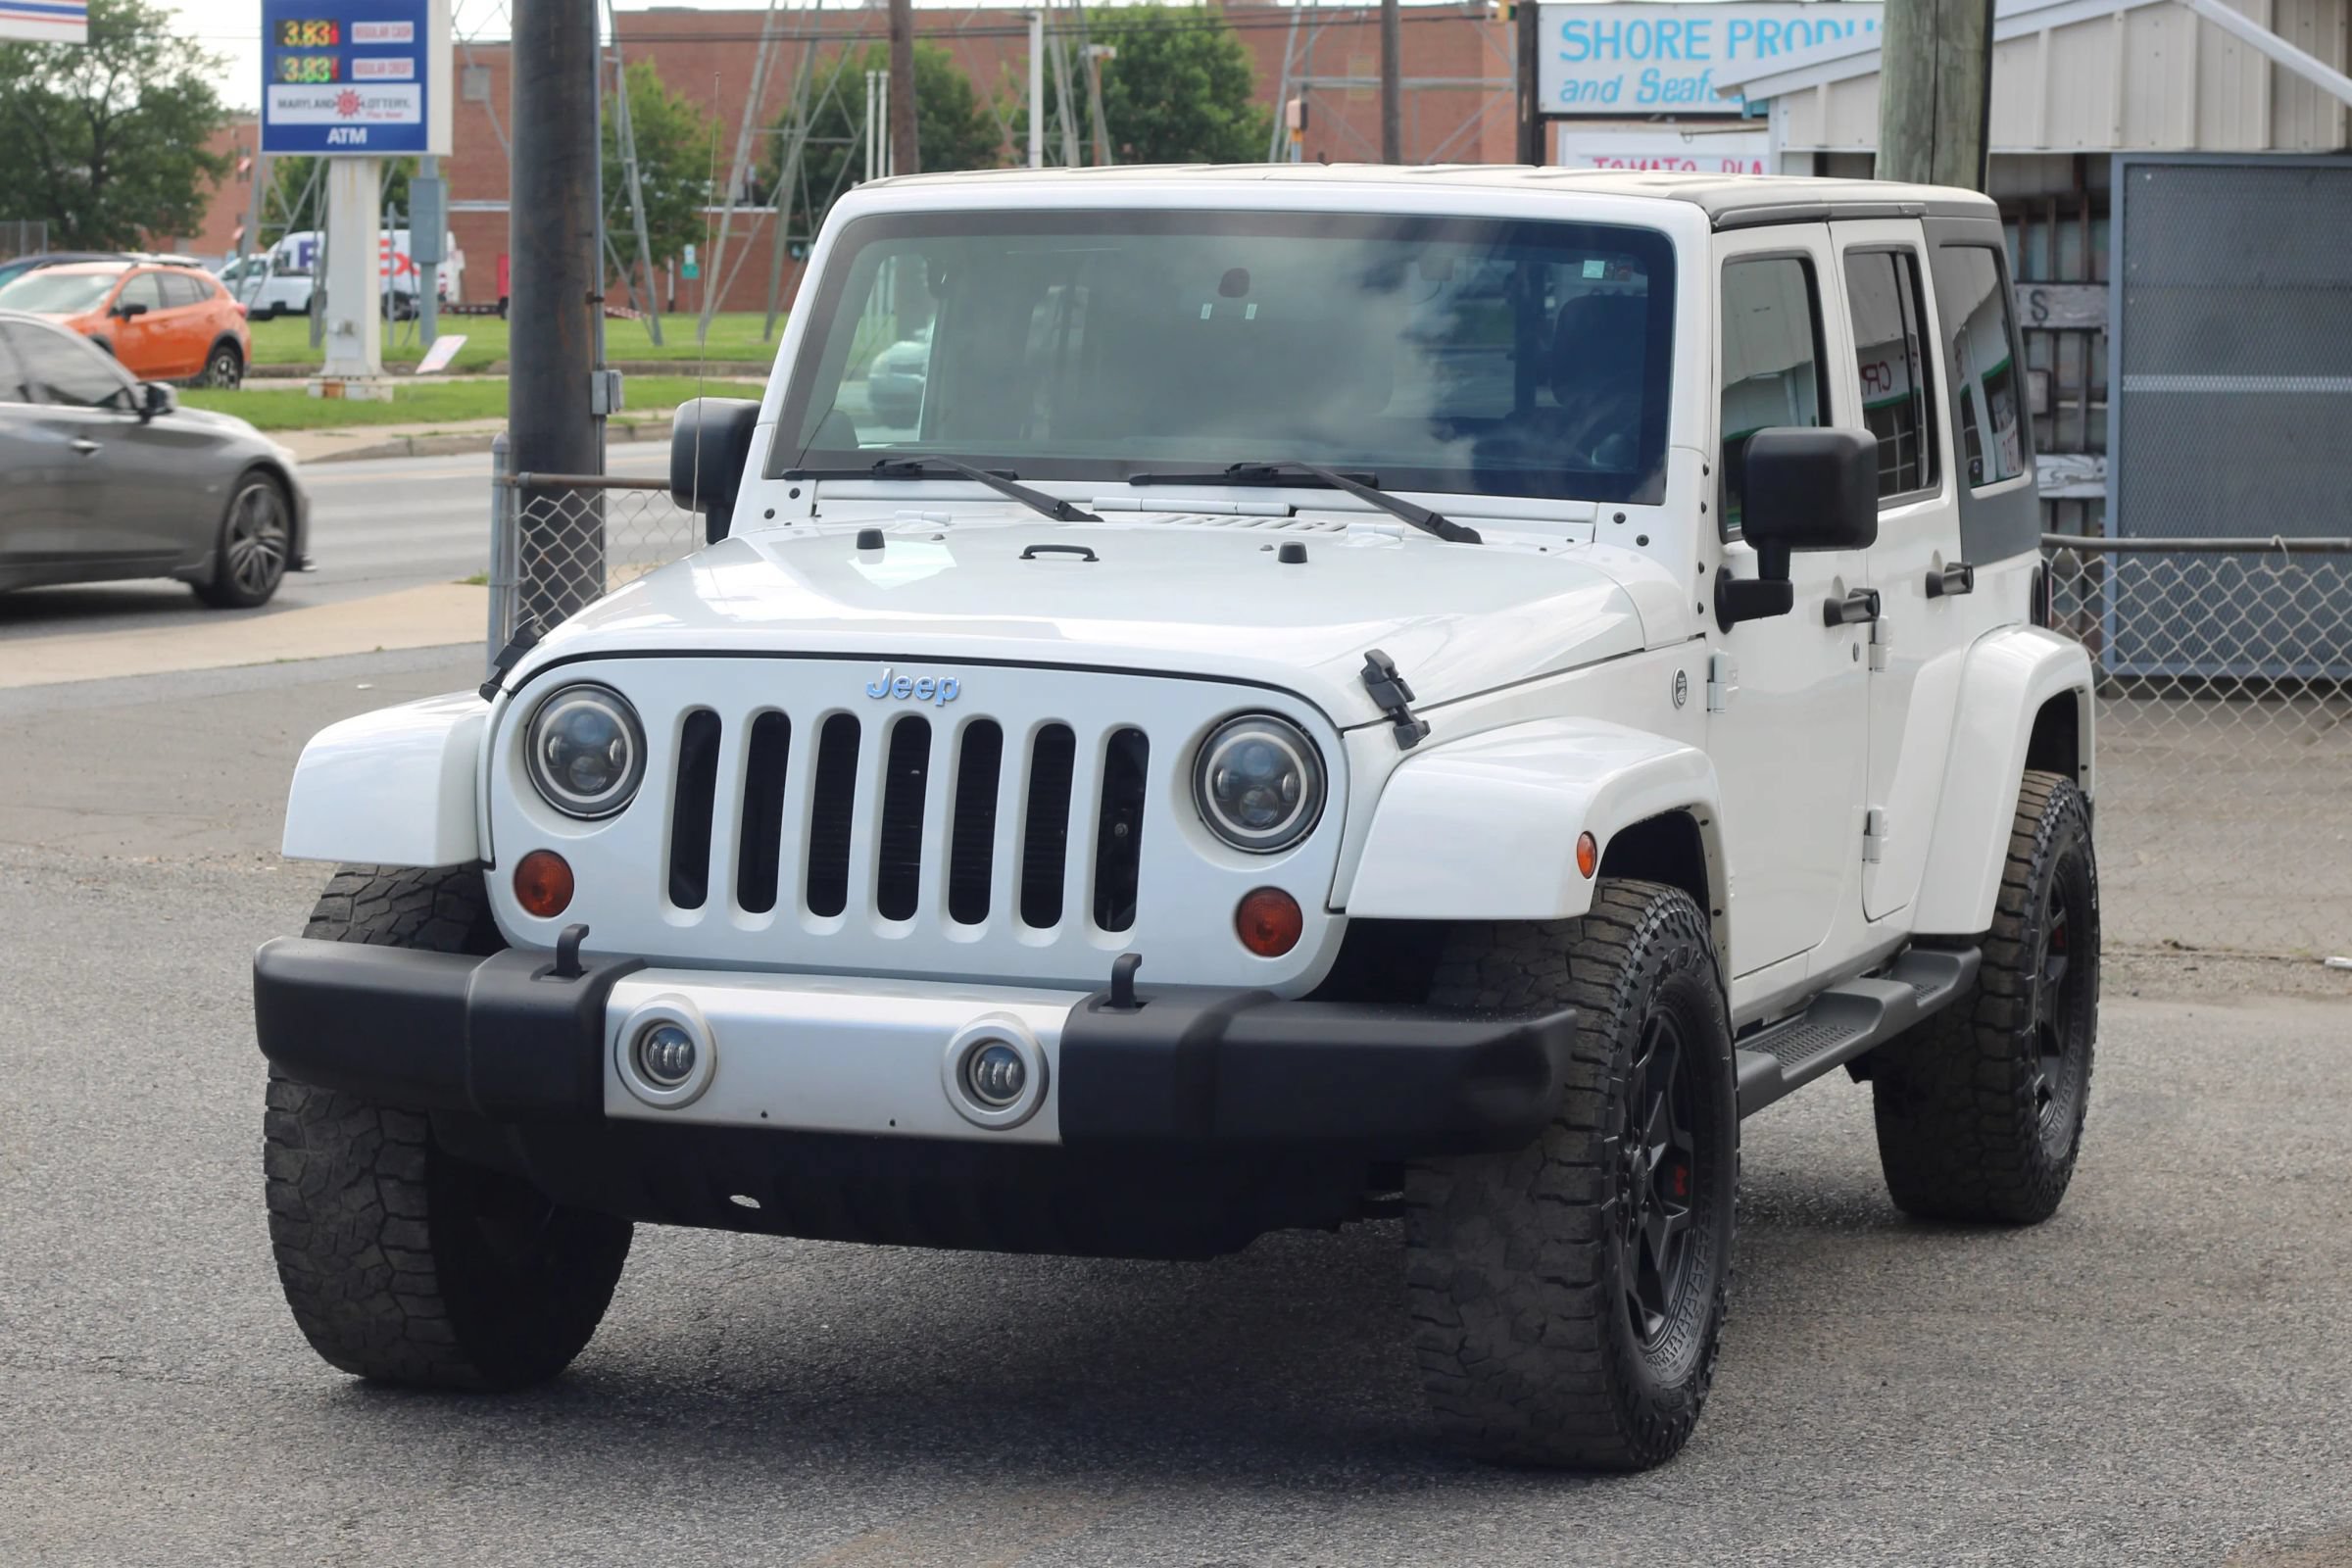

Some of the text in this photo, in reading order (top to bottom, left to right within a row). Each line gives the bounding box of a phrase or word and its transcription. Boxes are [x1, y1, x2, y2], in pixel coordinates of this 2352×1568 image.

[284, 21, 329, 46] 3.83
[1560, 19, 1712, 61] SHORE
[284, 57, 329, 81] 3.83
[1560, 68, 1743, 103] and Seaf
[277, 99, 334, 109] MARYLAND
[326, 127, 368, 145] ATM
[866, 667, 960, 707] Jeep
